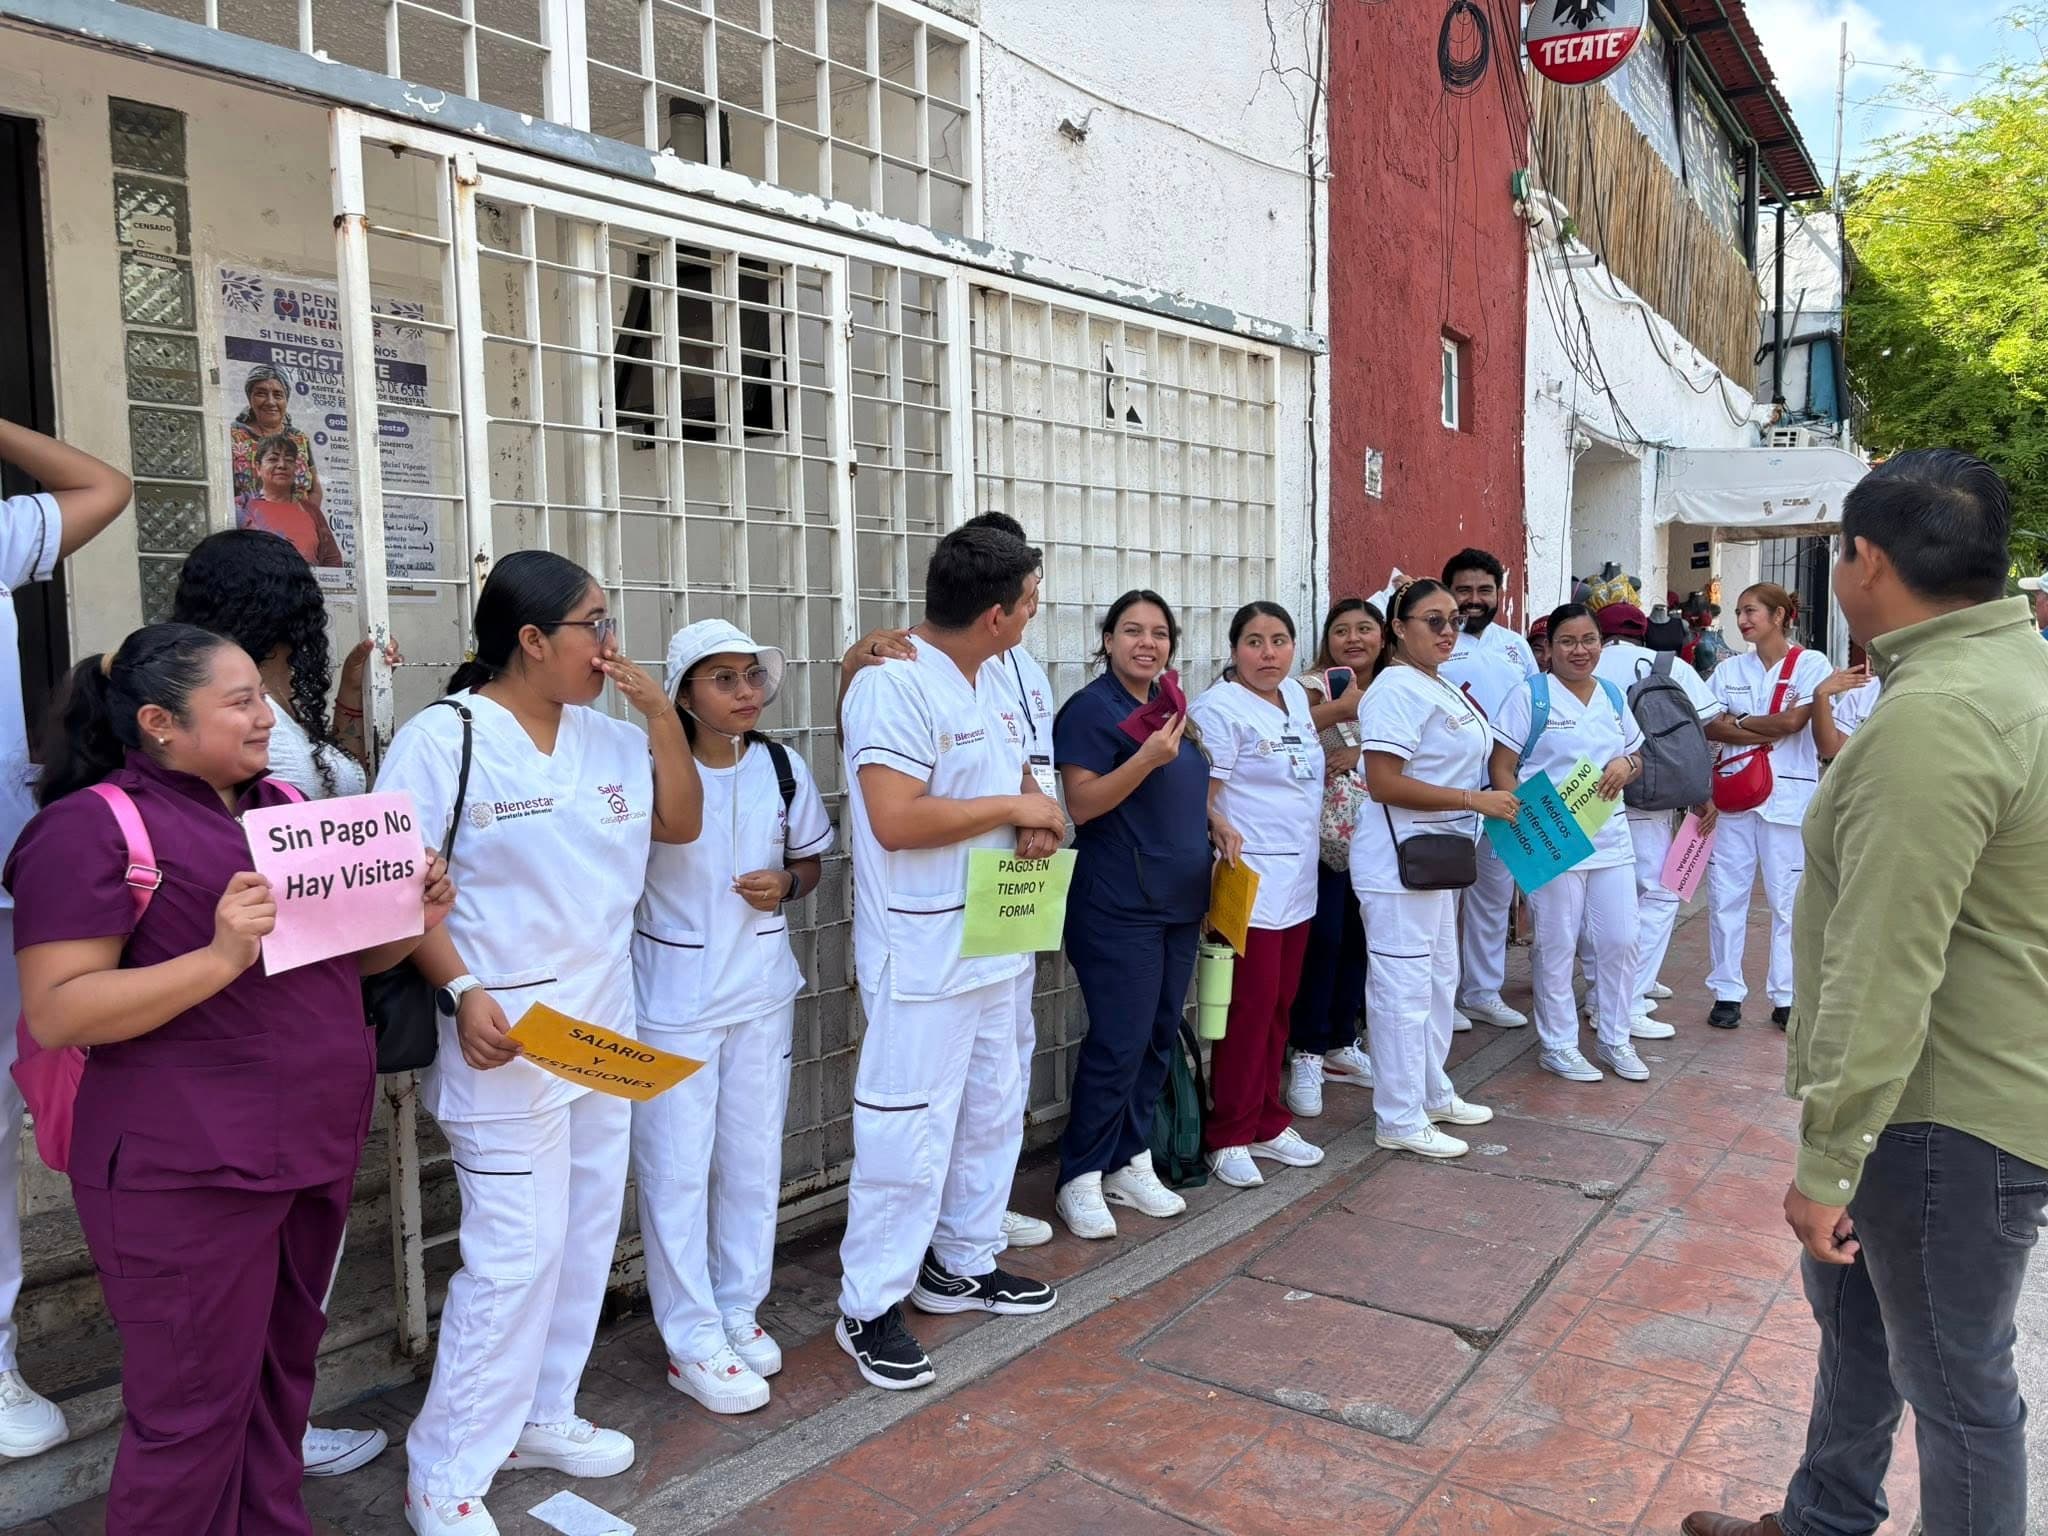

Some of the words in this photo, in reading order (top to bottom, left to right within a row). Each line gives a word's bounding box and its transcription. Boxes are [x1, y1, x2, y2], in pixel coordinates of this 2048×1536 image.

[1540, 32, 1624, 66] TECATE
[133, 222, 172, 232] CENSADO
[260, 328, 272, 339] SI
[274, 331, 318, 346] TIENES
[321, 338, 335, 349] 63
[374, 344, 398, 359] ÑOS
[1577, 763, 1593, 781] NO
[494, 796, 554, 816] Bienestar
[1540, 794, 1572, 839] Médicos
[268, 824, 313, 853] Sin
[319, 818, 379, 847] Pago
[383, 809, 412, 835] No
[1521, 804, 1563, 862] Enfermería
[999, 859, 1034, 873] PAGOS
[1035, 858, 1050, 871] EN
[1676, 838, 1698, 873] LABORAL
[286, 873, 335, 900] Hay
[341, 858, 415, 890] Visitas
[998, 881, 1036, 896] TIEMPO
[1038, 880, 1045, 893] Y
[999, 903, 1036, 918] FORMA
[569, 1028, 656, 1064] SALARIO
[592, 1056, 606, 1066] Y
